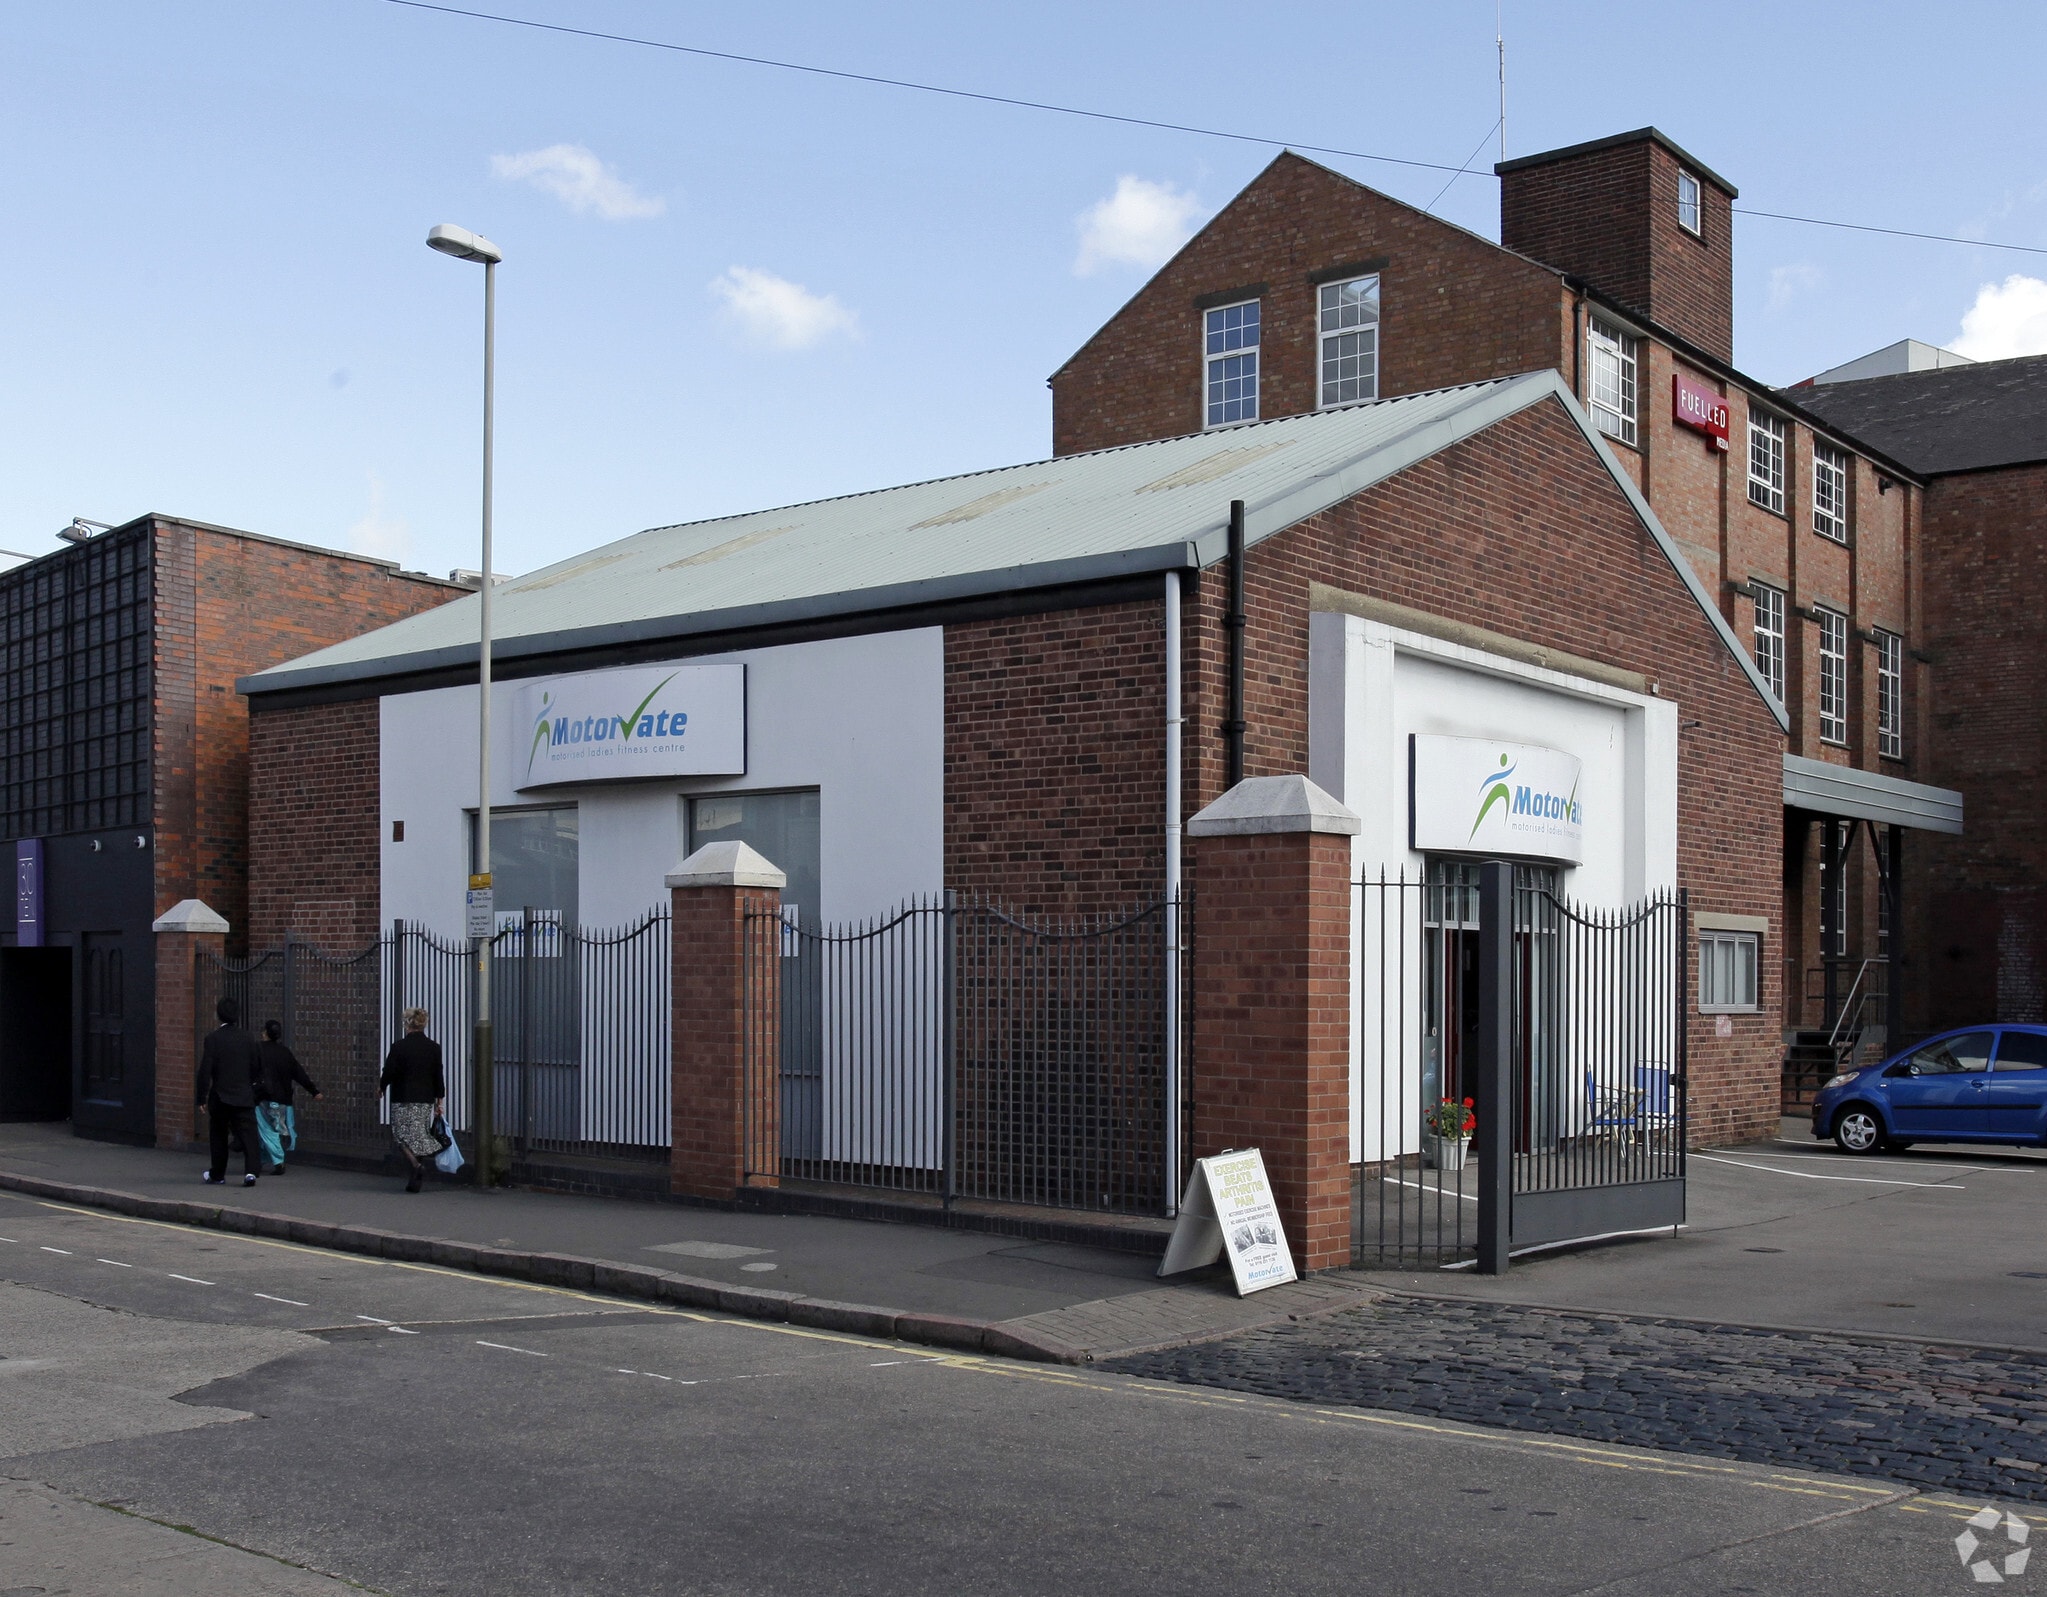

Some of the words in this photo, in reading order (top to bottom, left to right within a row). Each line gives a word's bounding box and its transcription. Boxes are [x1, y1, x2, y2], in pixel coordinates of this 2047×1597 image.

[1681, 389, 1726, 428] FUELLED
[551, 750, 585, 761] motorised
[588, 745, 613, 758] ladies
[618, 743, 648, 755] fitness
[652, 743, 685, 753] centre
[1511, 822, 1545, 833] motorised
[1213, 1158, 1258, 1176] EXERCISE
[1223, 1172, 1253, 1186] BEATS
[1219, 1180, 1264, 1200] ARTHRITIS
[1234, 1194, 1256, 1208] PAIN
